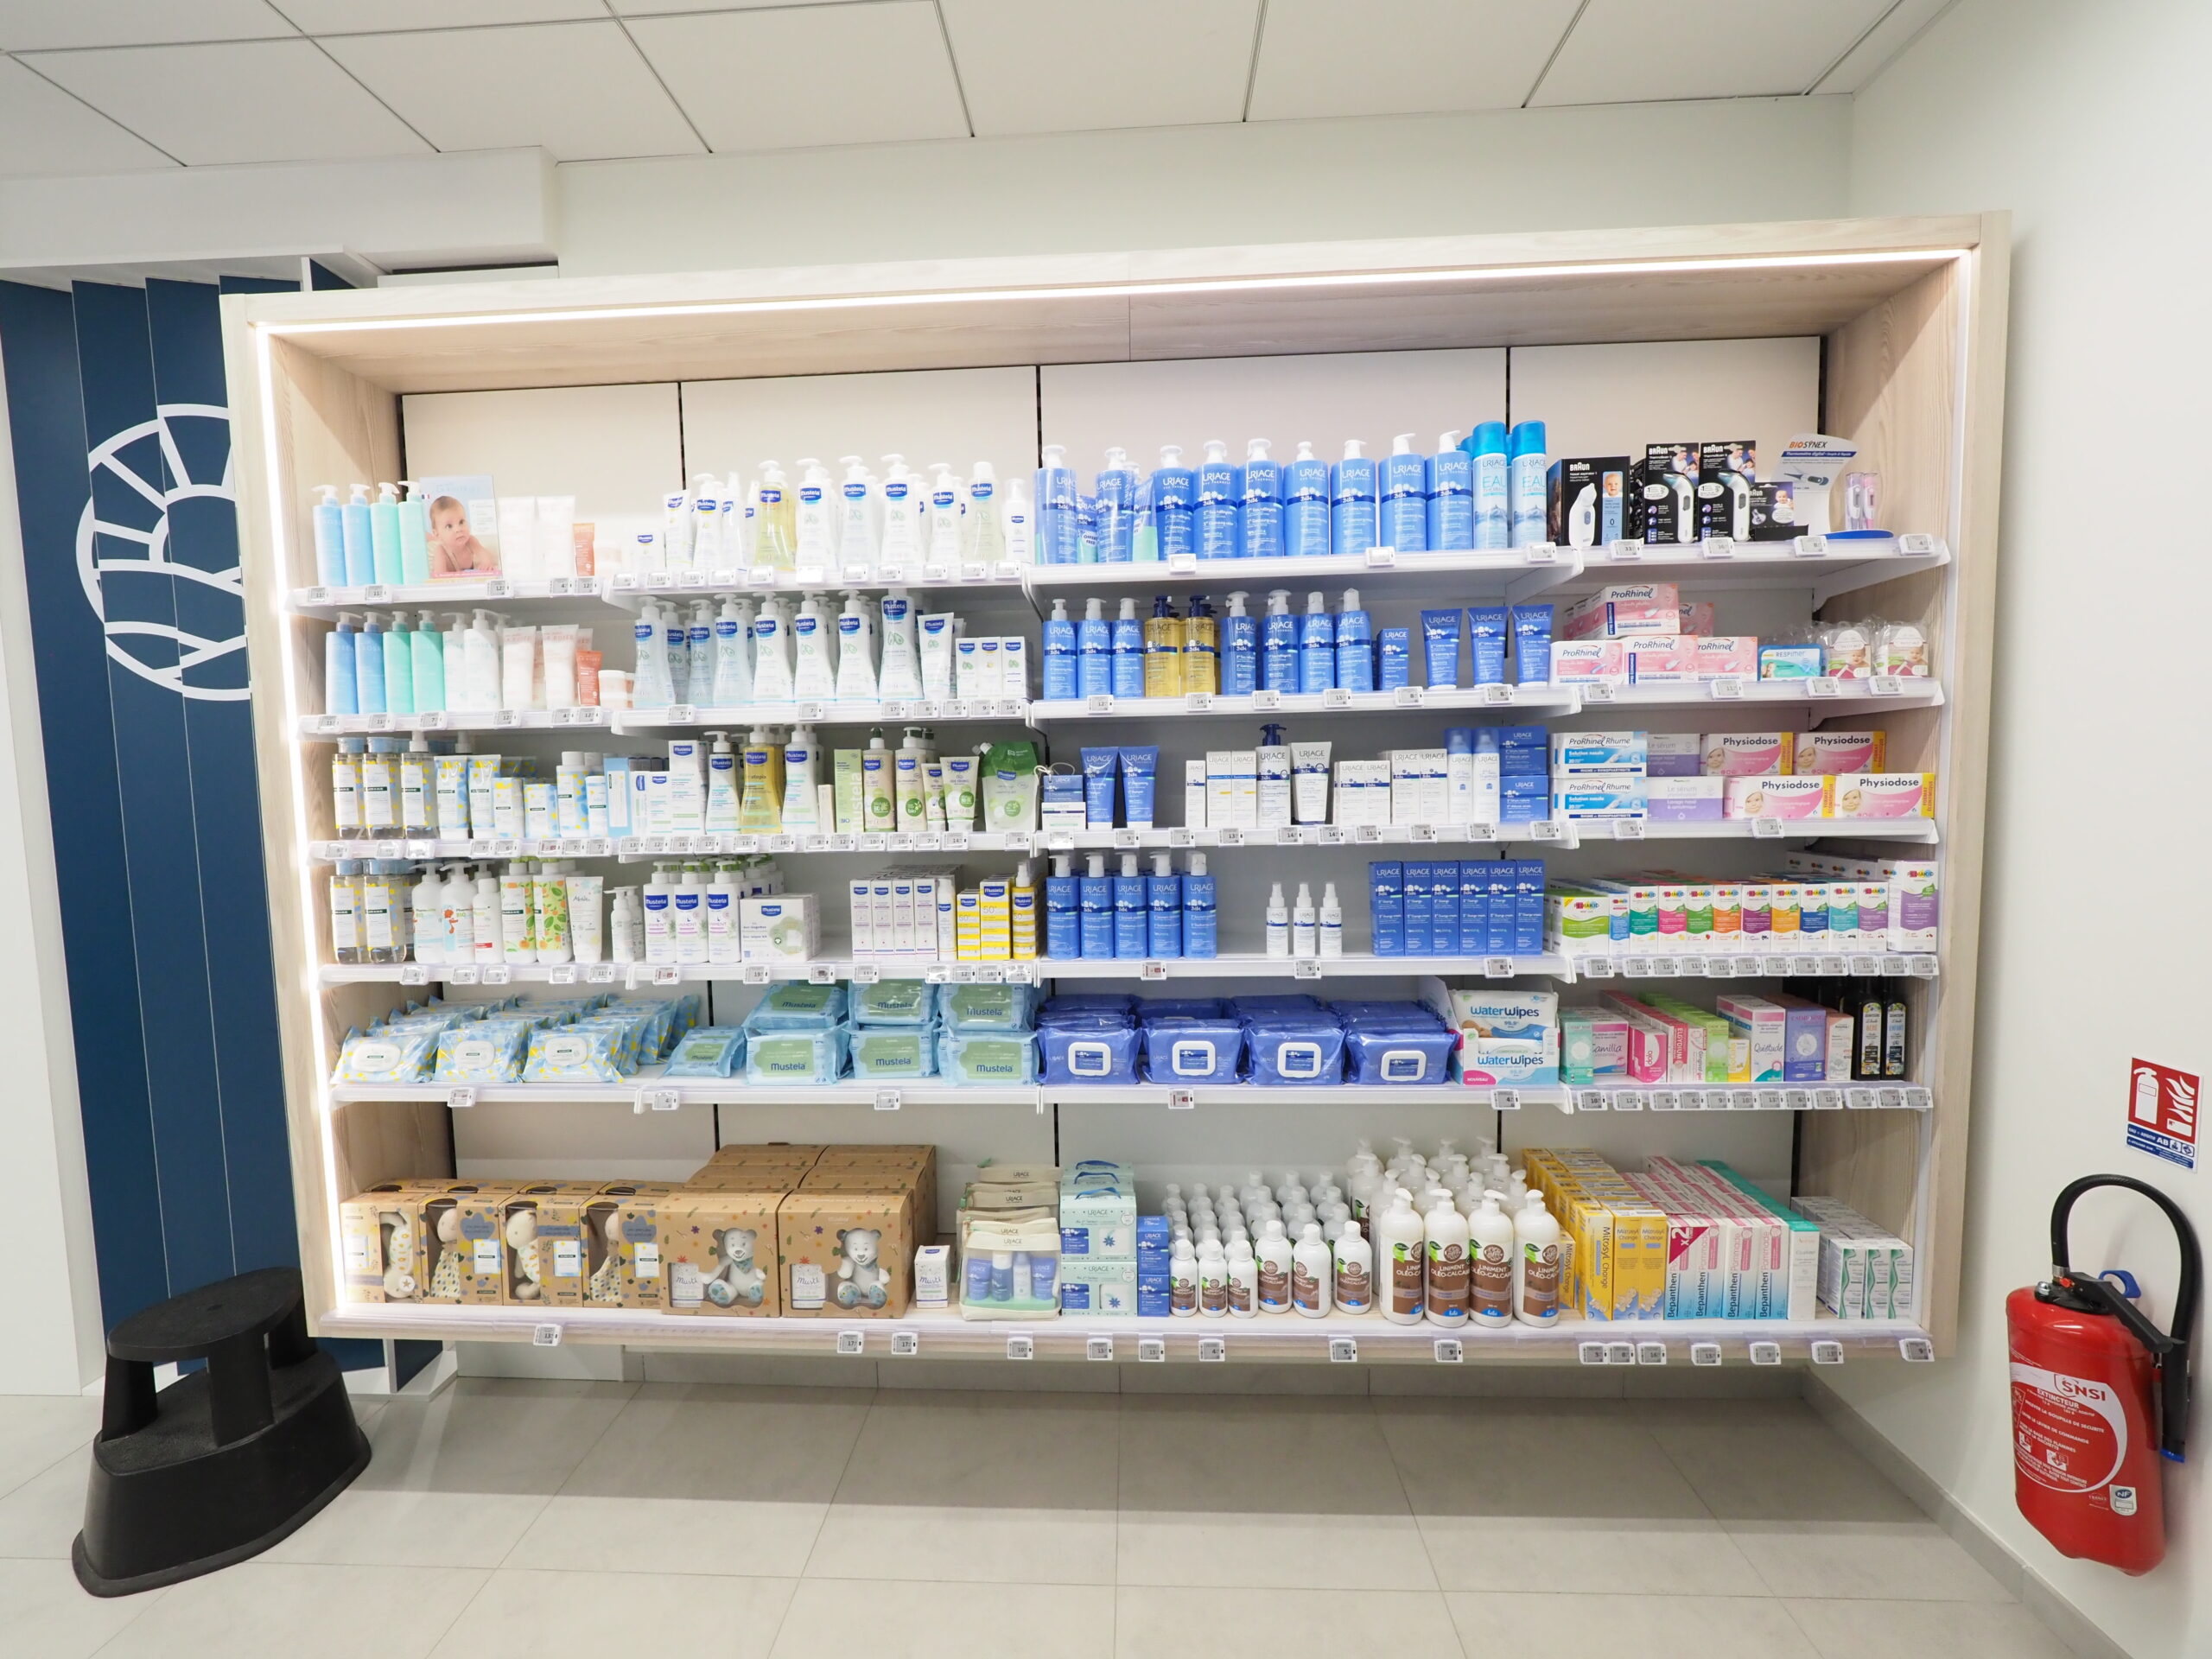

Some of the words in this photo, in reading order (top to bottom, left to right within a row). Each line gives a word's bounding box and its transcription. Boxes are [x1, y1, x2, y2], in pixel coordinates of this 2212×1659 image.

[1341, 467, 1370, 478] URIAGE
[1393, 463, 1422, 476] URIAGE
[1439, 461, 1468, 473] URIAGE
[1203, 472, 1231, 483] URIAGE
[1247, 468, 1275, 480] URIAGE
[1300, 468, 1326, 478] URIAGE
[1162, 476, 1190, 487] URIAGE
[1611, 588, 1654, 599] ProRhinel
[1339, 616, 1364, 626] URIAGE
[1429, 615, 1456, 625] URIAGE
[1521, 612, 1548, 620] URIAGE
[1049, 626, 1074, 634] URIAGE
[1085, 626, 1109, 634] URIAGE
[1115, 625, 1141, 634] URIAGE
[1268, 620, 1294, 631] URIAGE
[1633, 639, 1675, 651] ProRhinel
[1562, 647, 1602, 658] ProRhinel
[1568, 736, 1605, 747] ProRhinel
[1723, 736, 1778, 747] Physiodose
[1815, 735, 1871, 746] Physiodose
[1299, 749, 1325, 758] URIAGE
[1421, 753, 1446, 761] URIAGE
[1569, 782, 1605, 792] ProRhinel
[1762, 780, 1820, 790] Physiodose
[1859, 778, 1919, 788] Physiodose
[1376, 868, 1400, 876] URIAGE
[1406, 868, 1430, 876] URIAGE
[1462, 867, 1486, 875] URIAGE
[1048, 885, 1071, 893] URIAGE
[1083, 885, 1107, 893] URIAGE
[1117, 884, 1141, 893] URIAGE
[1153, 884, 1177, 893] URIAGE
[1190, 883, 1214, 892] URIAGE
[1470, 1005, 1540, 1019] WaterWipes
[1477, 1054, 1544, 1067] WaterWipes
[2156, 1136, 2169, 1146] AB
[1602, 1226, 1611, 1260] Mitosyl
[1699, 1232, 1708, 1270] Pommade
[1732, 1233, 1741, 1271] Pommade
[1761, 1232, 1770, 1270] Pommade
[1599, 1261, 1609, 1289] Change
[1668, 1273, 1677, 1319] Bepanthen
[1696, 1272, 1706, 1318] Bepanthen
[1728, 1273, 1738, 1318] Bepanthen
[1759, 1272, 1769, 1318] Bepanthen
[2062, 1380, 2106, 1401] SNSI
[2037, 1388, 2080, 1408] EXTINCTEUR
[2049, 1411, 2072, 1424] GOUPILLE
